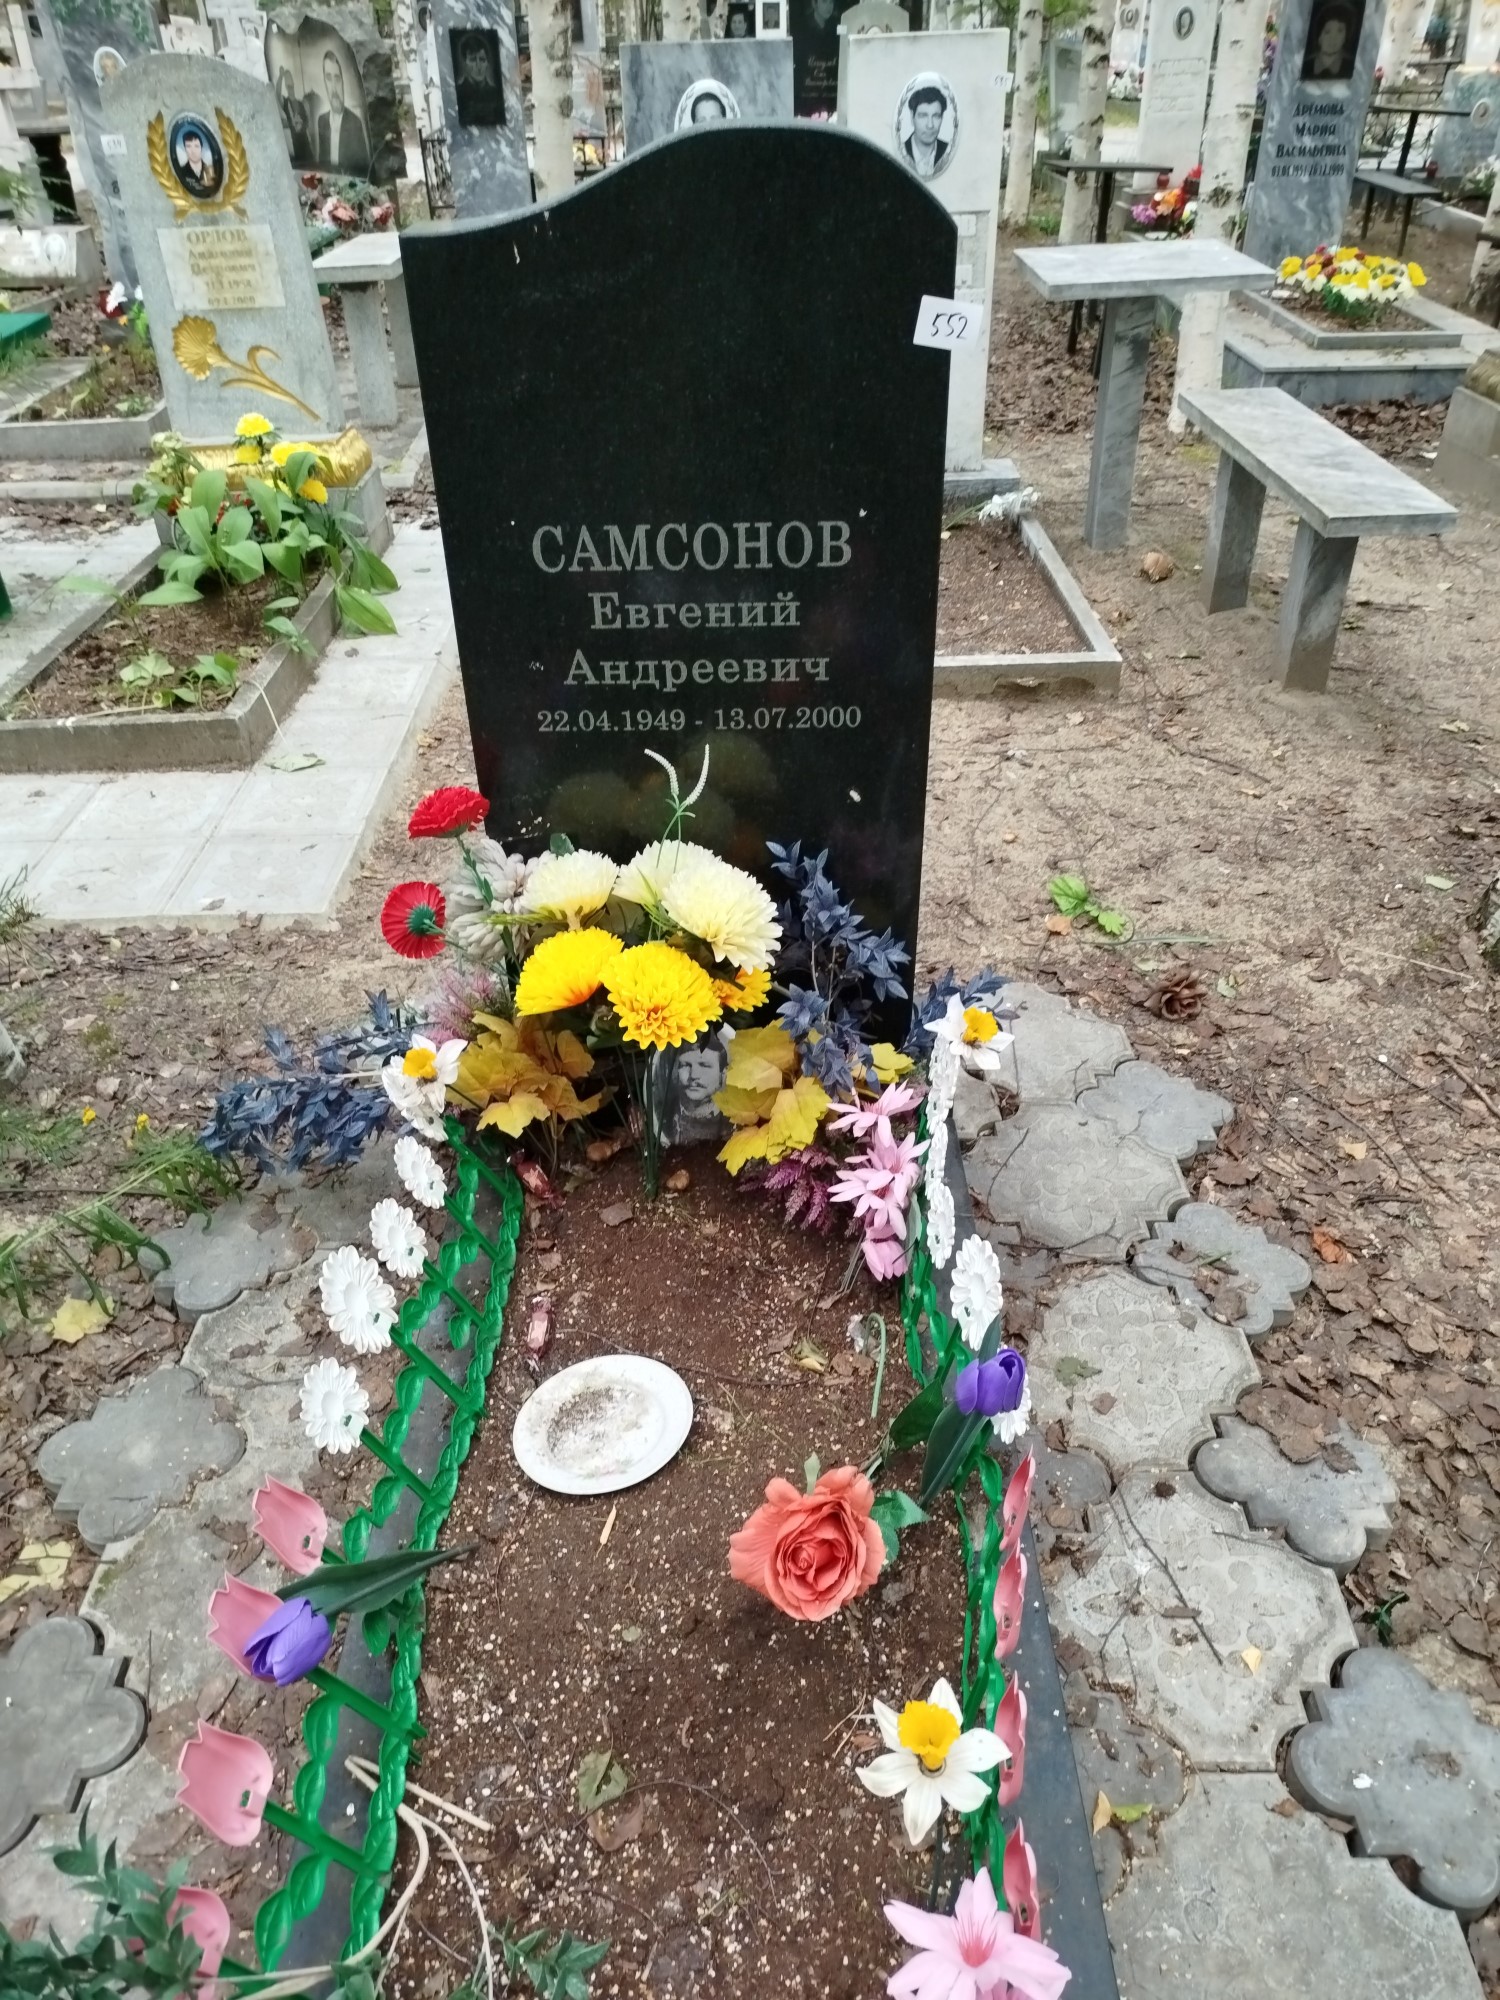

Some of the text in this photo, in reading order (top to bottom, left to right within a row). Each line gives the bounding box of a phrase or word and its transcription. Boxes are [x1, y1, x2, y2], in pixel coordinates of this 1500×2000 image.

[186, 228, 248, 245] ОРЛОВ
[930, 312, 968, 340] 552
[531, 520, 853, 573] САМСОНОВ
[588, 592, 801, 630] Евгений
[564, 649, 830, 692] Андреевич
[537, 708, 686, 733] 22.04.1949
[714, 706, 862, 731] 13.07.2000
